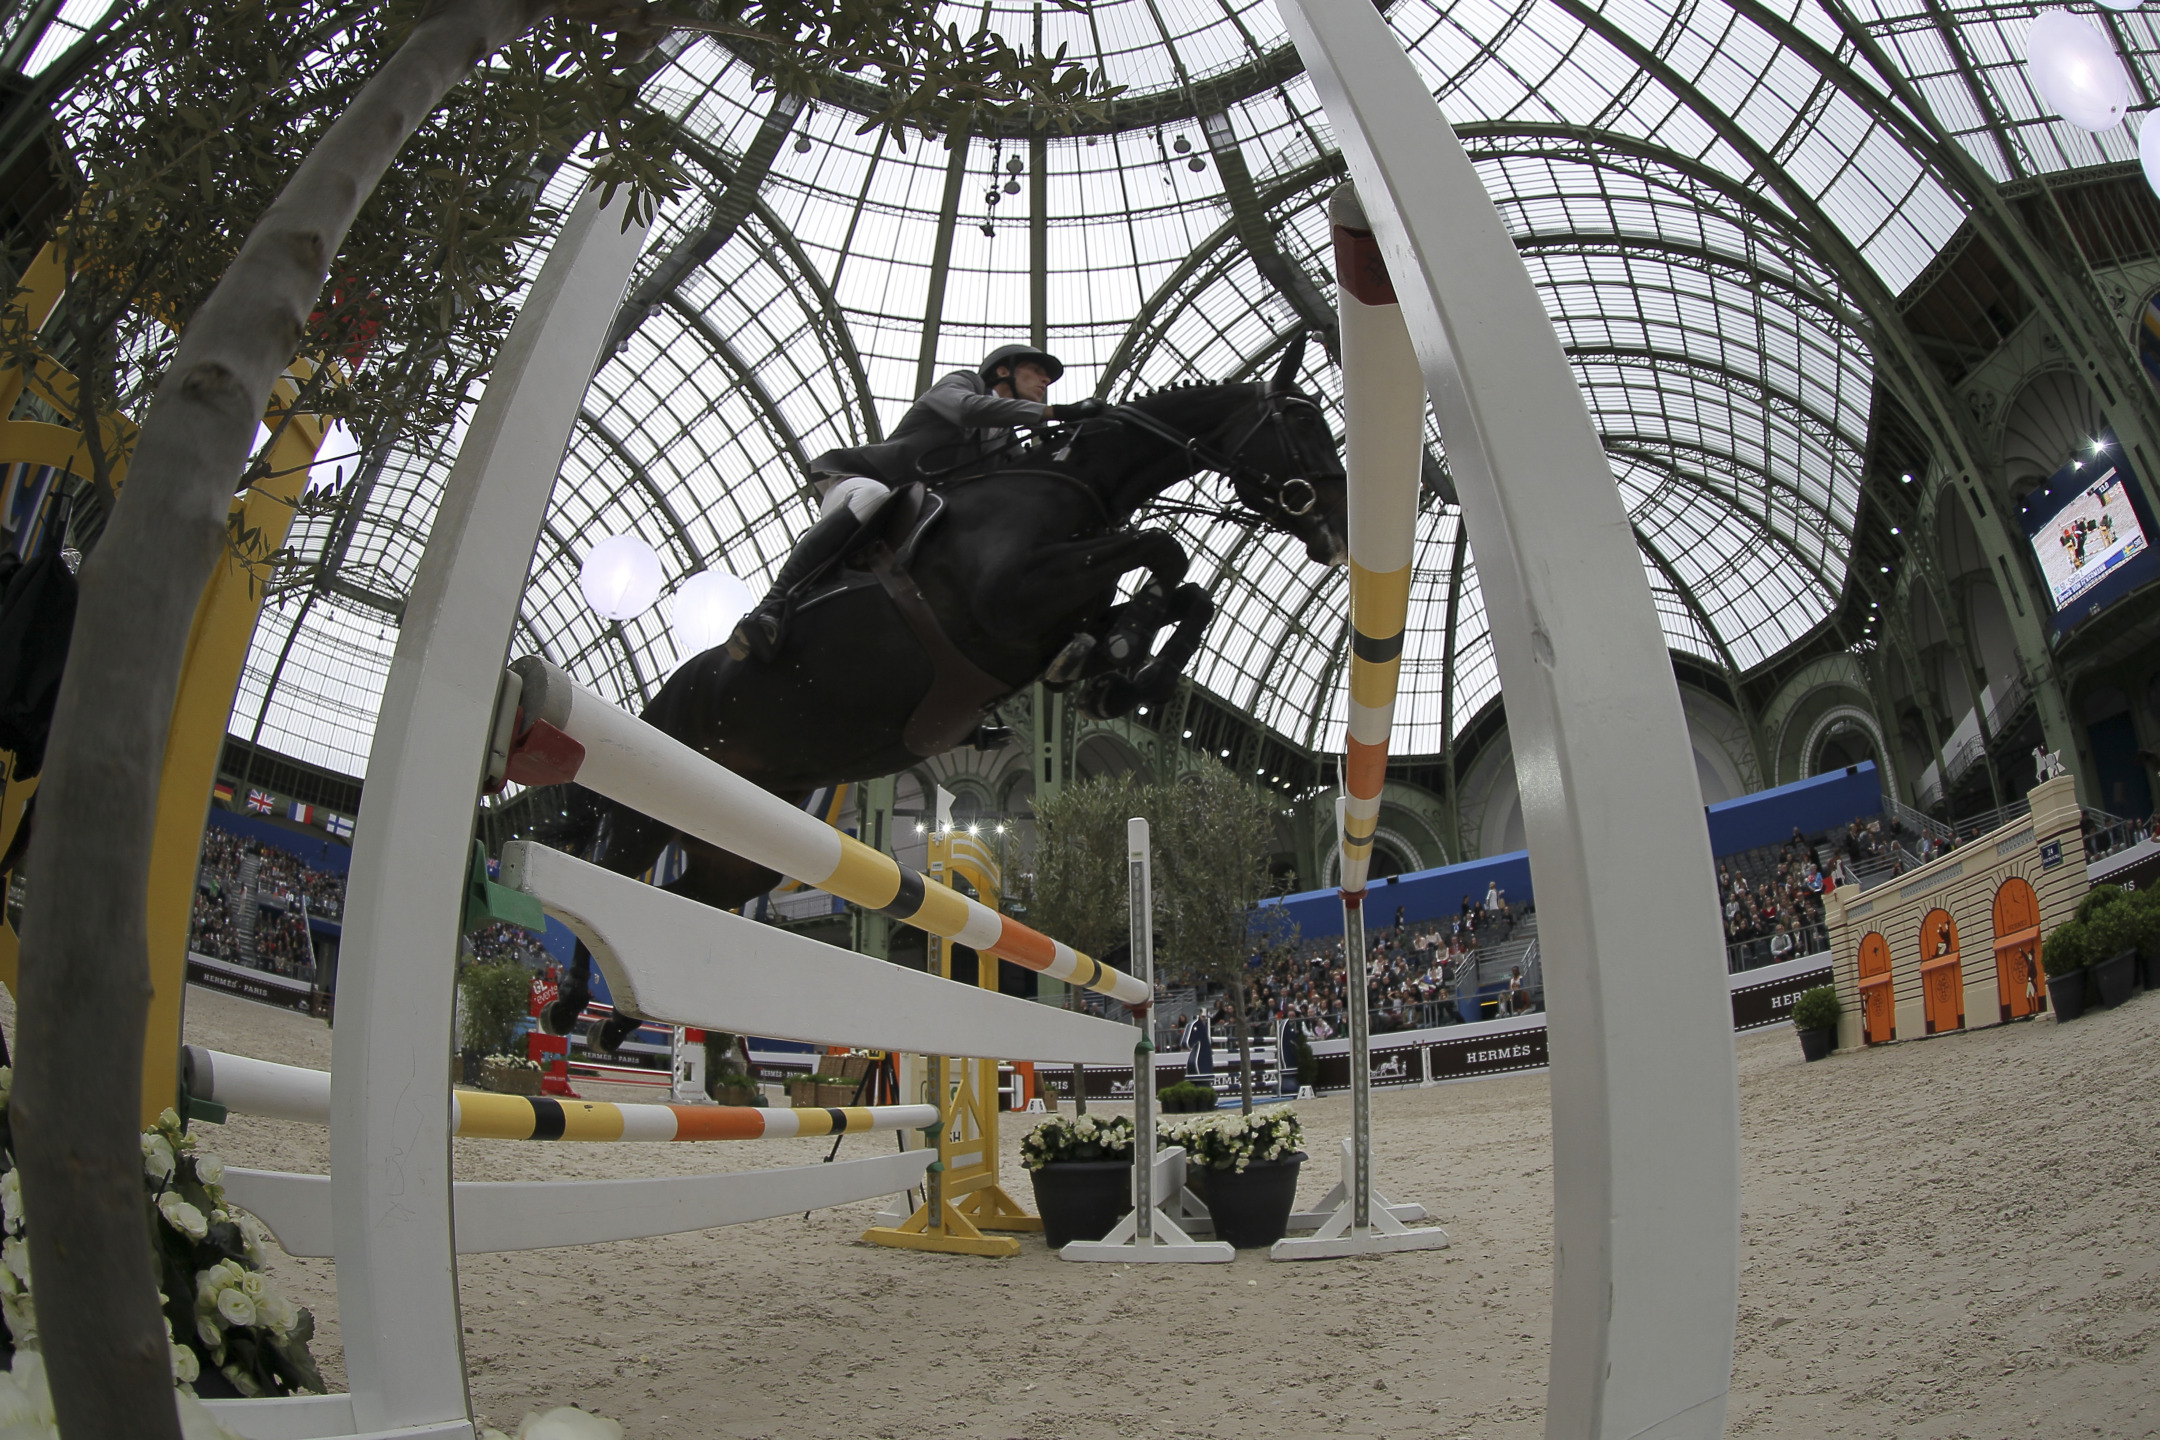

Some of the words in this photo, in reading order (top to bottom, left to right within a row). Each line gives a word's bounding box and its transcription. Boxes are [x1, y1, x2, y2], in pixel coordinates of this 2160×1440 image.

[2047, 848, 2053, 856] 24
[244, 984, 268, 996] PARIS
[533, 979, 548, 995] GL
[618, 1055, 640, 1064] PARIS
